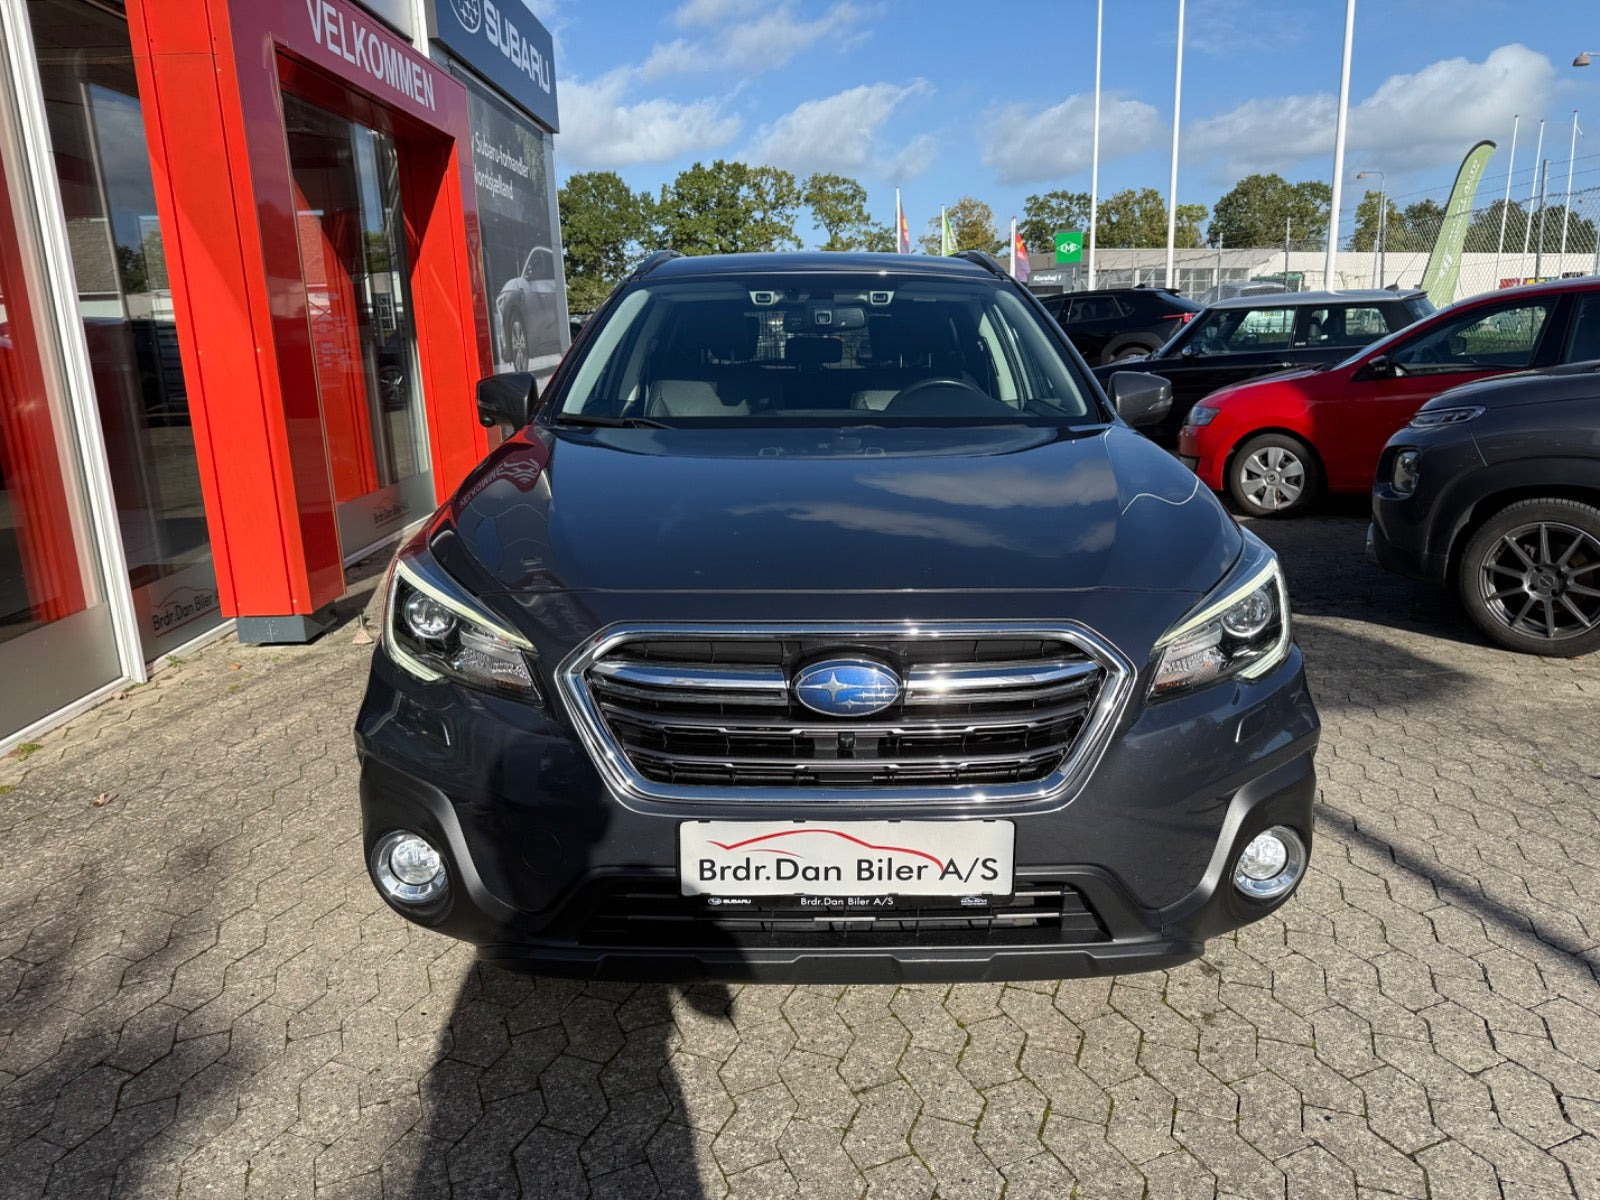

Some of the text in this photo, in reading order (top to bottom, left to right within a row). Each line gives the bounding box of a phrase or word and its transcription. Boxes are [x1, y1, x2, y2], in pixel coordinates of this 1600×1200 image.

[306, 0, 436, 111] VELKOMMEN
[483, 0, 550, 94] SUBARU
[194, 594, 213, 612] Biler
[699, 857, 999, 883] Brdr.Dan Biler A/S
[800, 897, 894, 906] Brdr.Dan Biler A/S
